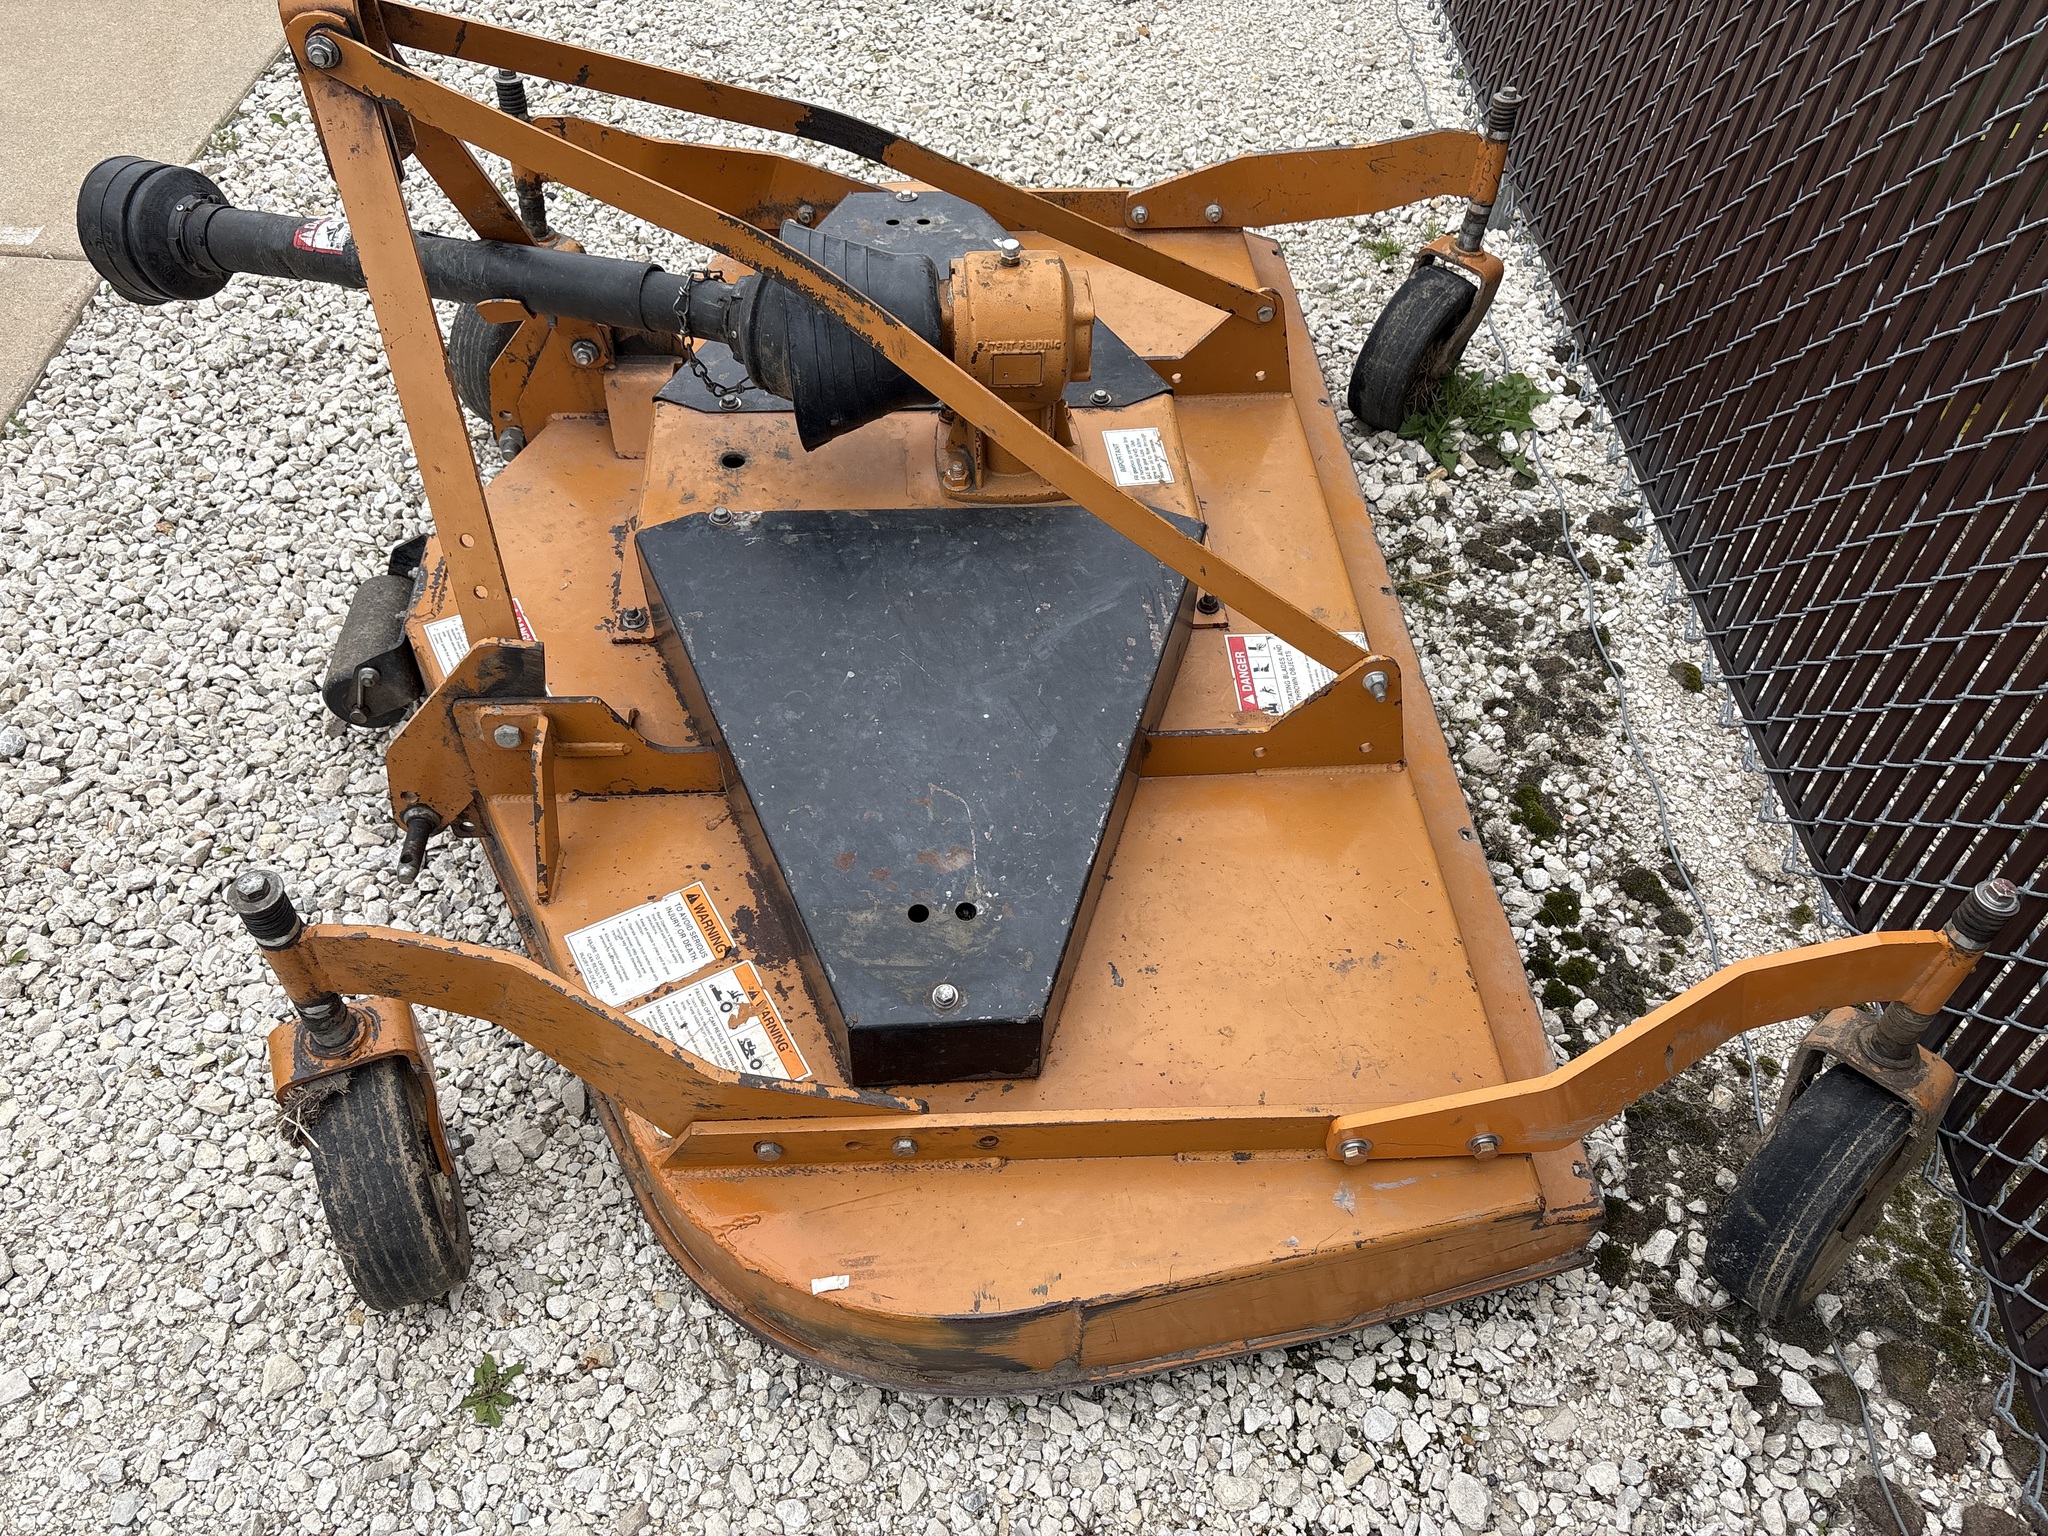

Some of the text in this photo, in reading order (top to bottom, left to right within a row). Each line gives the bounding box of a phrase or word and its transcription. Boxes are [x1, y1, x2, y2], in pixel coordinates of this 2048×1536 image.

[977, 339, 1062, 352] PATENT PENDING
[1113, 444, 1126, 472] IMPORTANT
[1235, 651, 1252, 692] DANGER
[1279, 657, 1289, 679] BLADES
[1285, 651, 1302, 701] THROWN OBJECTS
[665, 906, 681, 927] INJURY
[677, 929, 686, 939] OR
[674, 902, 708, 958] TO AVOID SERIOUS
[694, 903, 727, 953] WARNING
[663, 1022, 676, 1043] EQUIPME
[694, 988, 706, 1007] FALLING
[708, 1017, 716, 1027] CAN
[714, 1027, 726, 1044] RESULT
